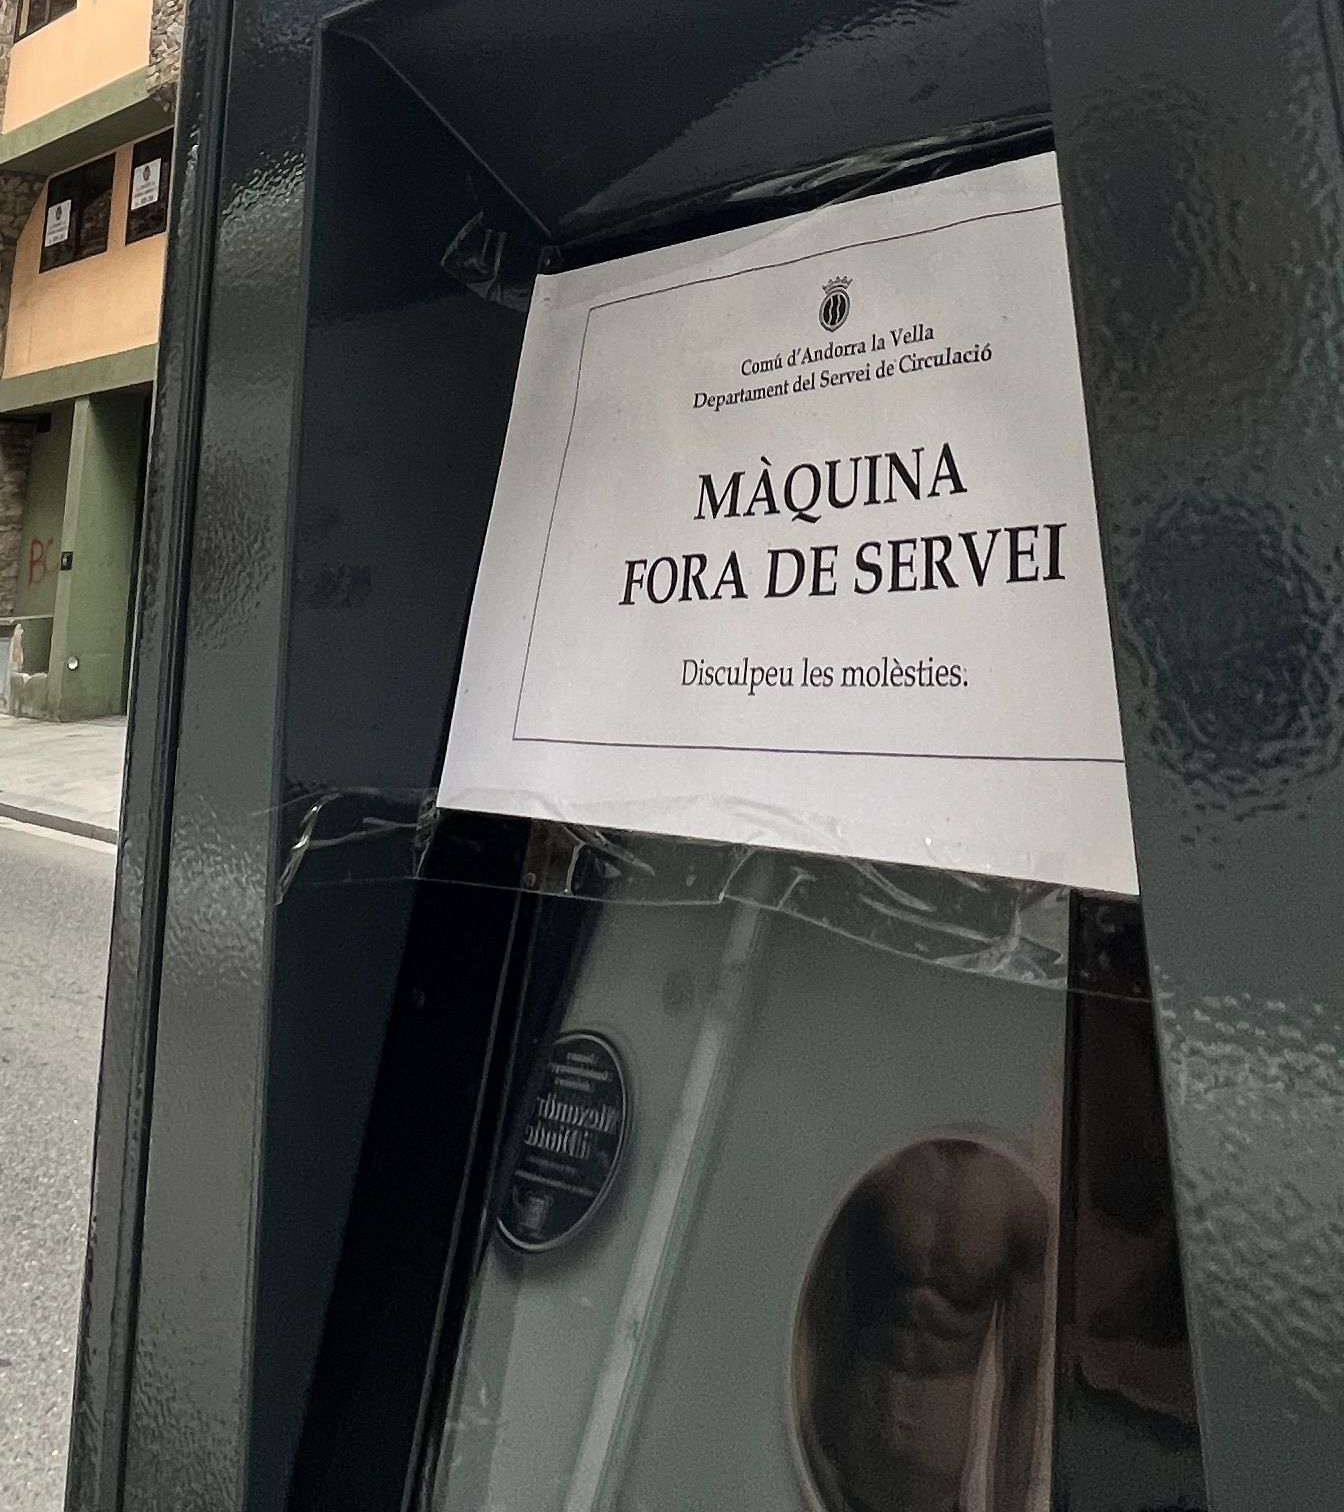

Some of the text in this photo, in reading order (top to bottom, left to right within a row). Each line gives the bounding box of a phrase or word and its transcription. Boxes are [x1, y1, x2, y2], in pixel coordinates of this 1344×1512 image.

[692, 343, 993, 412] Departament del Servei de Circulació
[741, 323, 935, 377] Comú d'Andorra la Vella
[693, 442, 968, 524] MÀQUINA
[618, 522, 1068, 606] FORA DE SERVEI
[681, 656, 969, 696] Disculpeu les molèsties.
